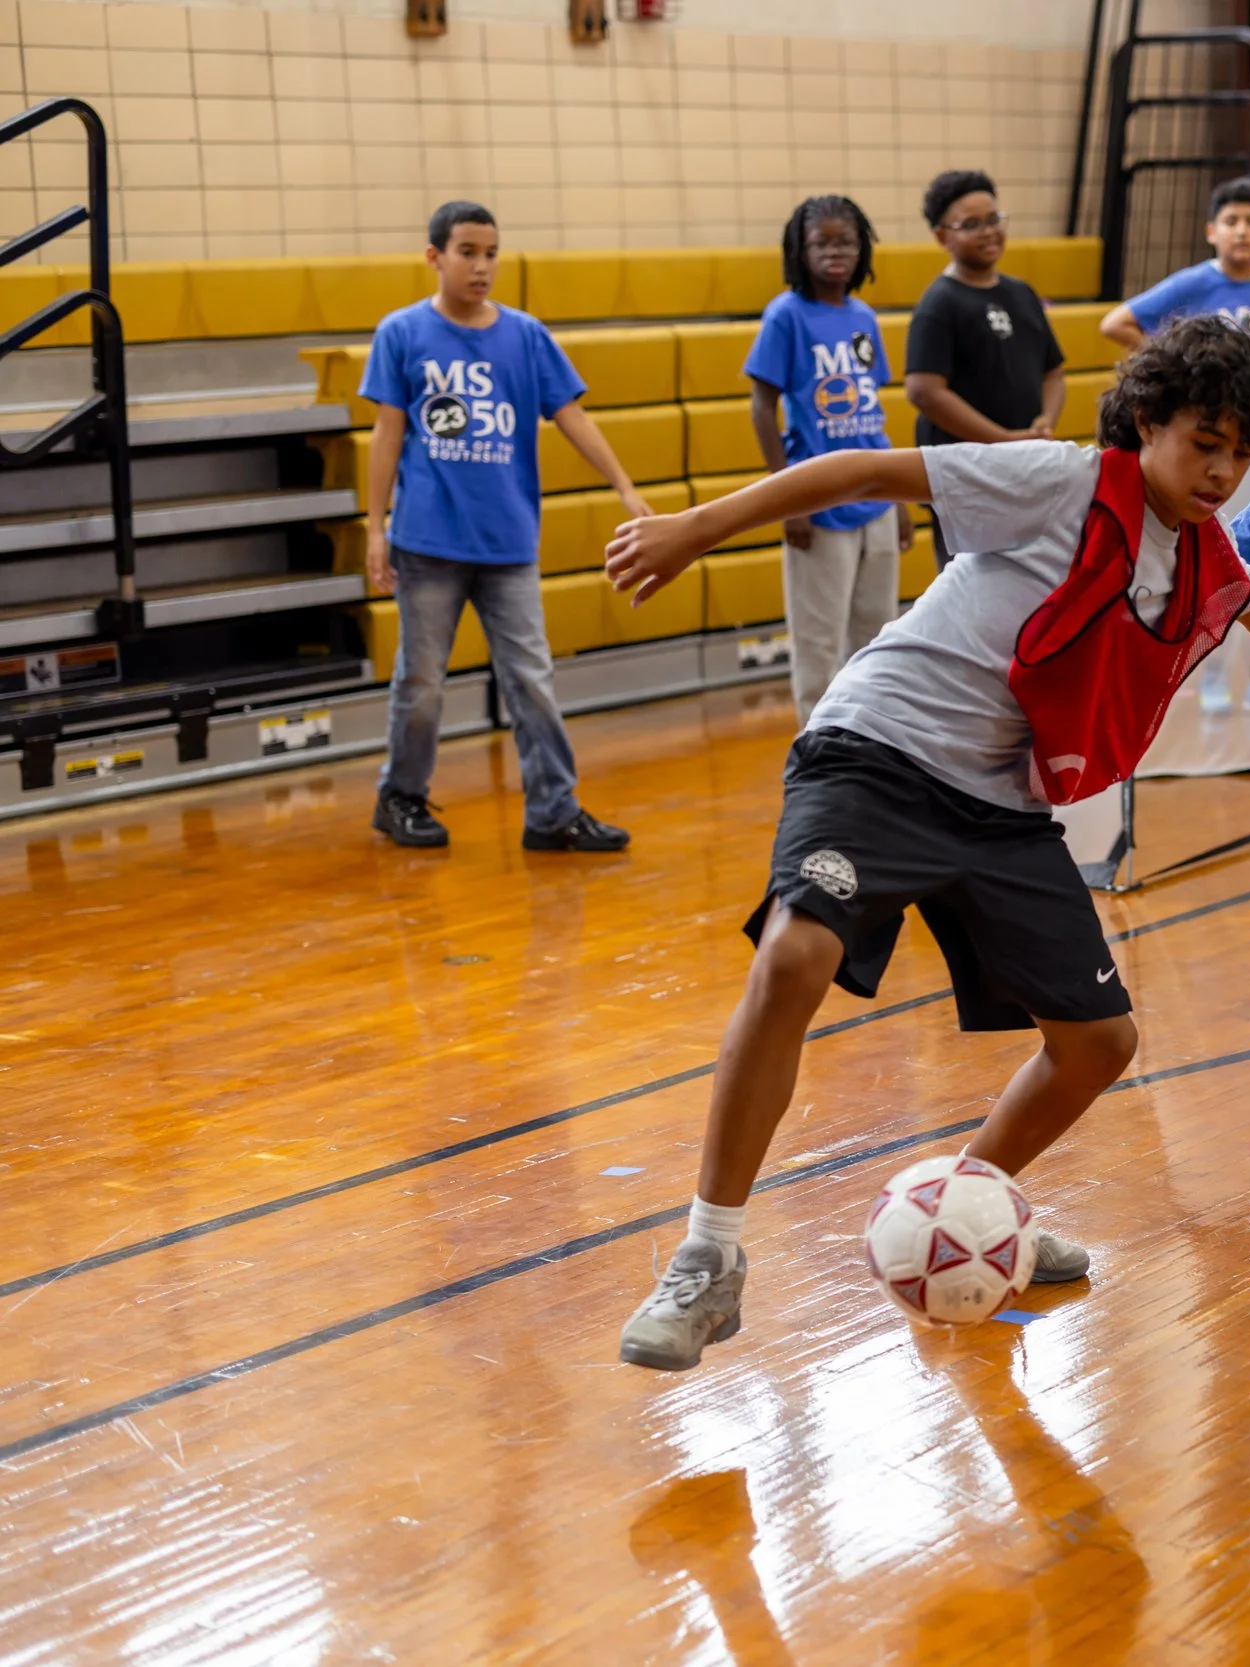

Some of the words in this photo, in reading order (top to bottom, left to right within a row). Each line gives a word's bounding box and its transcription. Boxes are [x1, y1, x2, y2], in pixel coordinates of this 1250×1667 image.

[421, 359, 493, 398] MS
[429, 405, 467, 433] 23
[472, 399, 516, 438] 50
